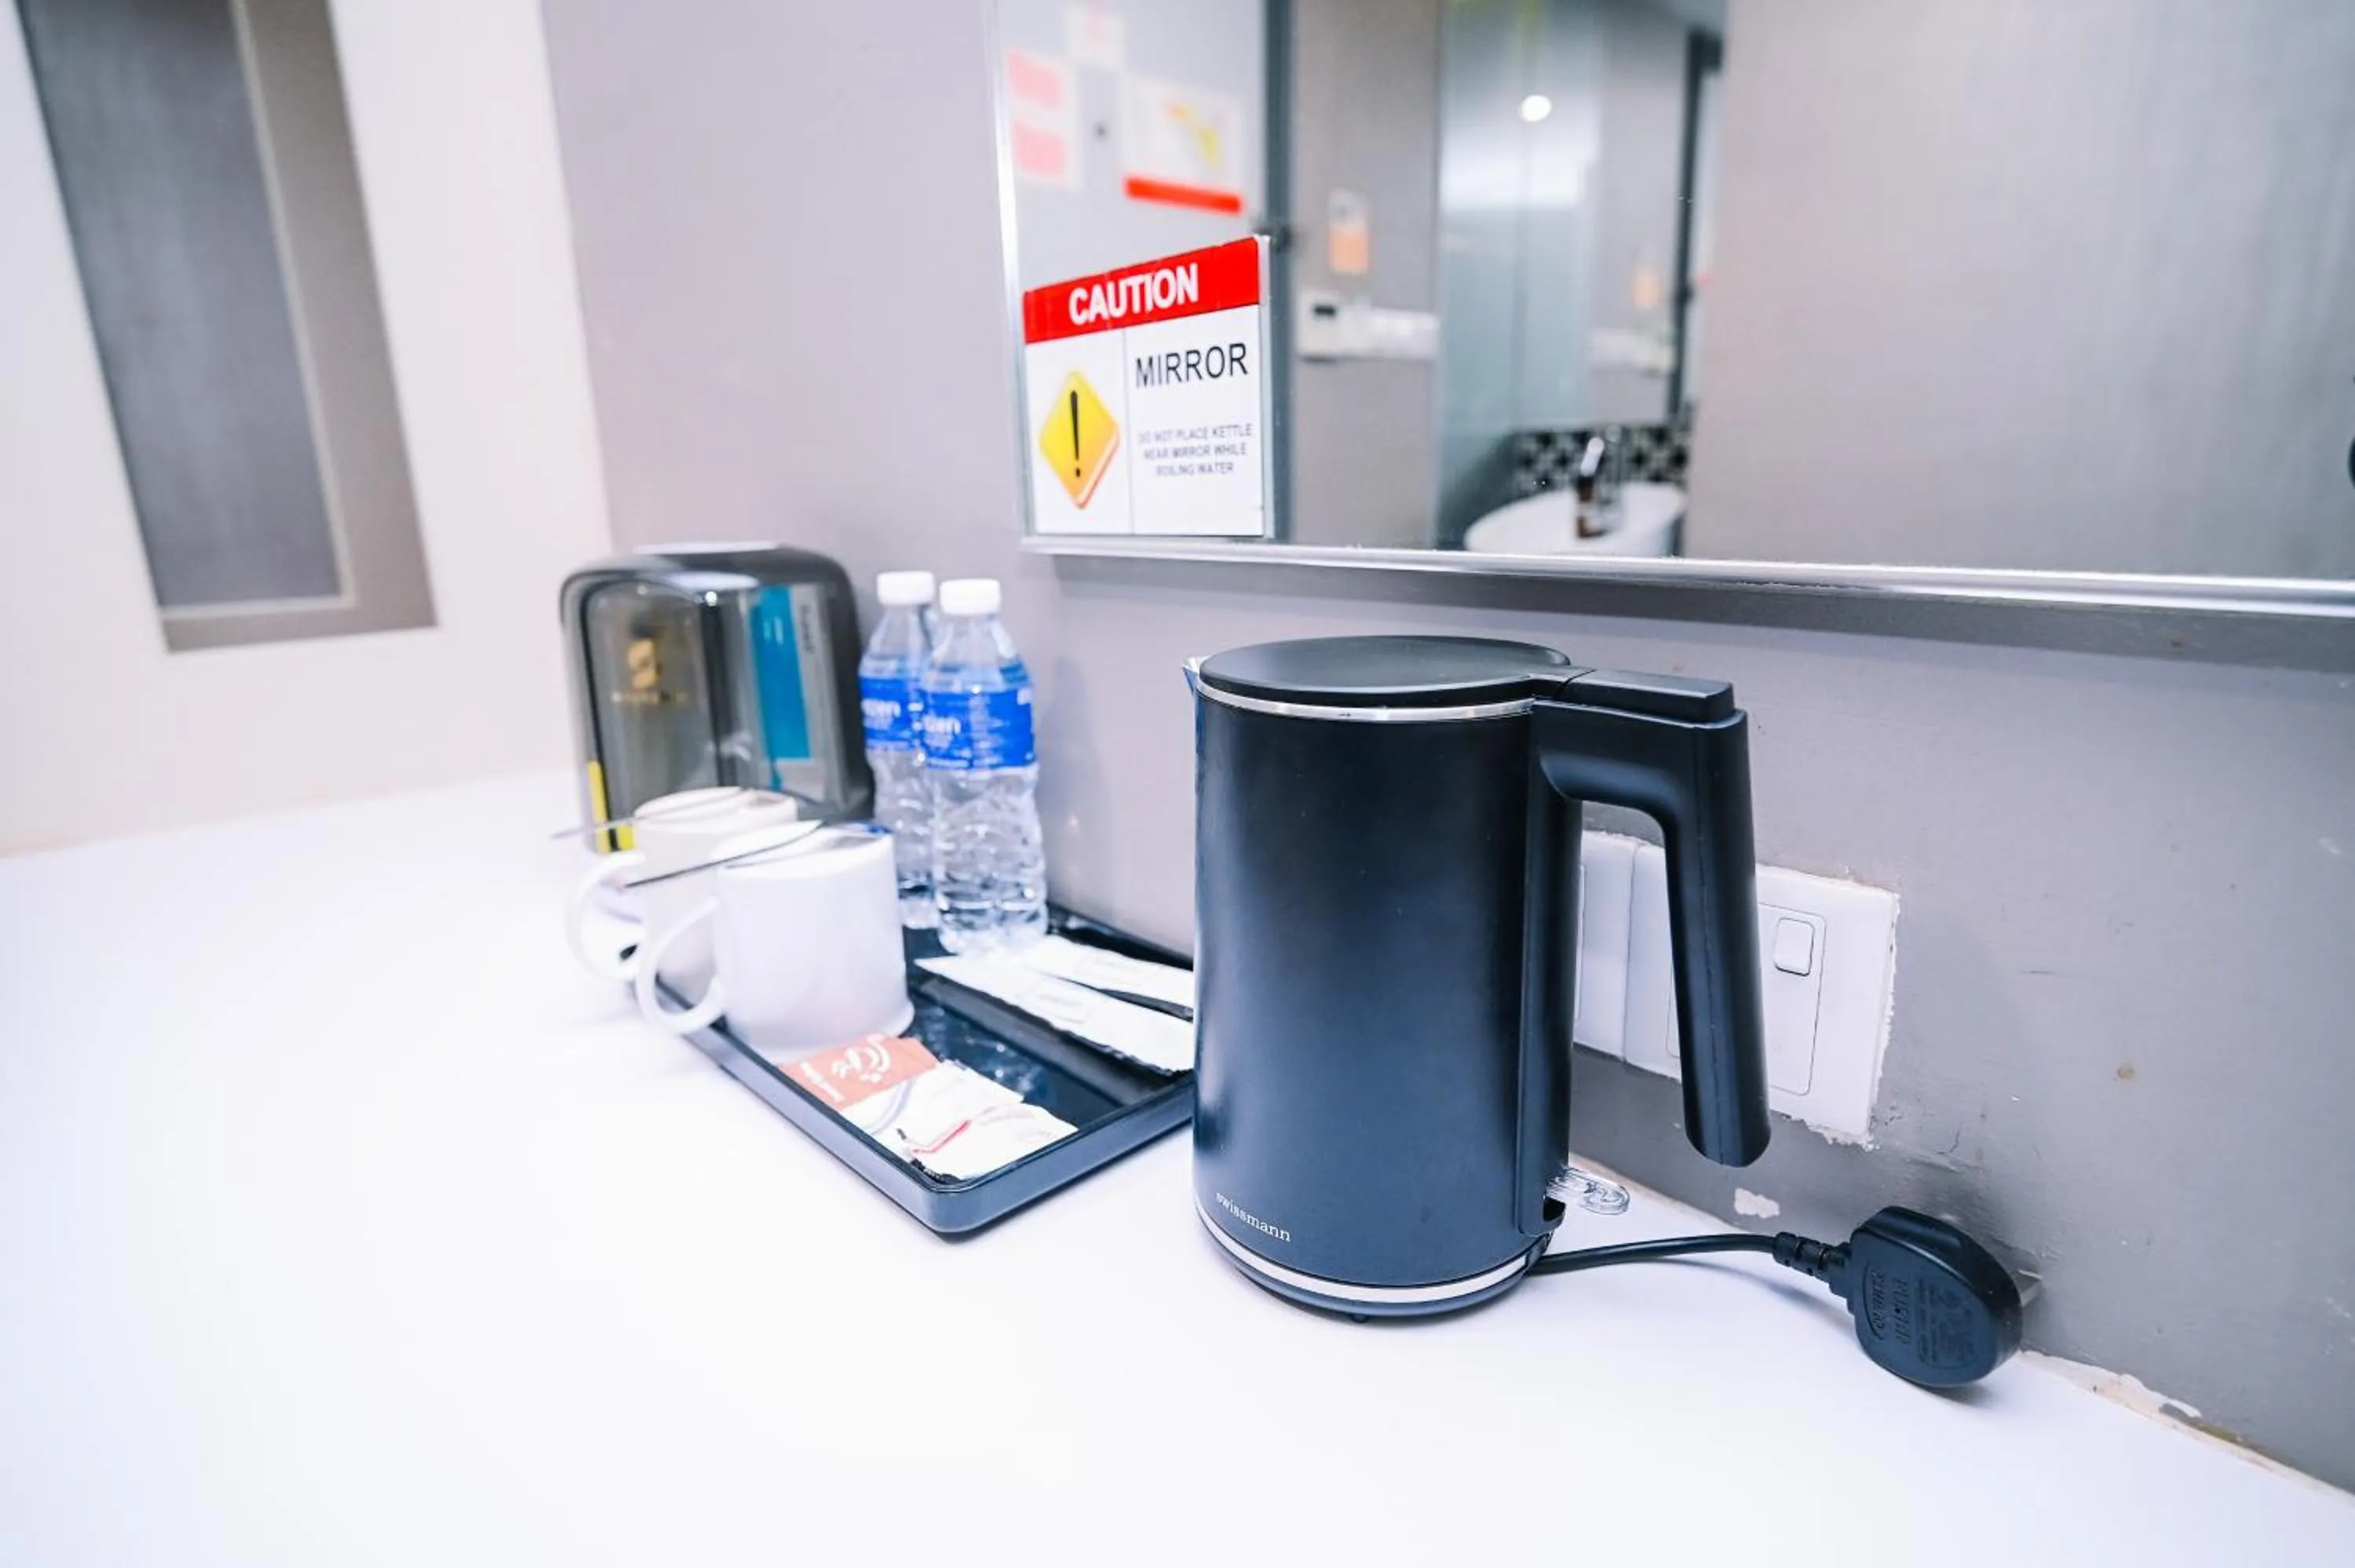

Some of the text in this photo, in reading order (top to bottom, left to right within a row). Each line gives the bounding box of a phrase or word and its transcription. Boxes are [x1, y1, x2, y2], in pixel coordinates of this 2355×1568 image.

[1068, 263, 1199, 326] CAUTION
[1135, 342, 1248, 388] MIRROR
[1176, 427, 1208, 441] PLACE
[1211, 423, 1253, 439] KETTLE
[1144, 442, 1247, 459] NEAR MIRROR WHILE
[1156, 461, 1234, 477] BOILING WATER
[1216, 1192, 1291, 1243] swissmann
